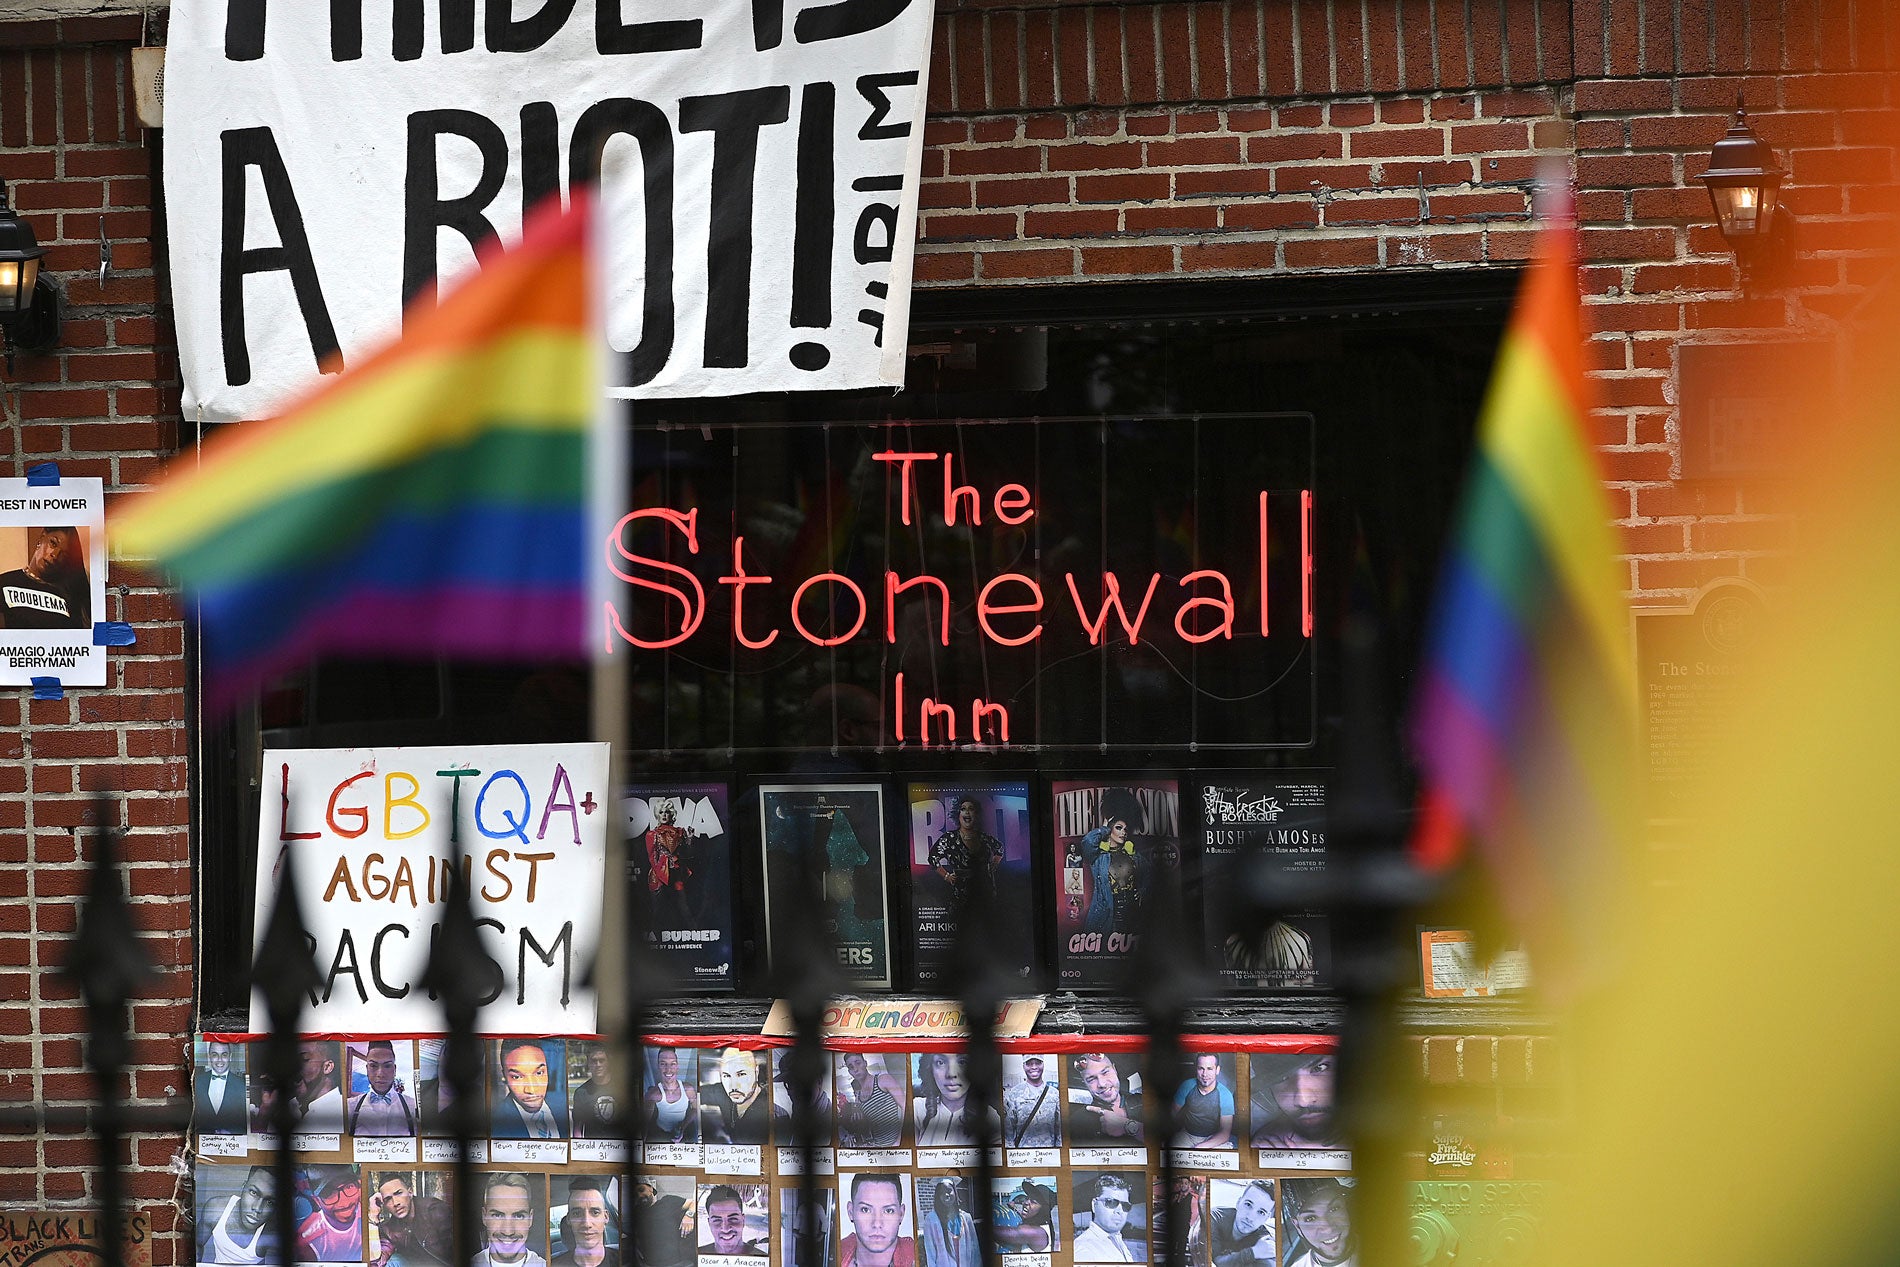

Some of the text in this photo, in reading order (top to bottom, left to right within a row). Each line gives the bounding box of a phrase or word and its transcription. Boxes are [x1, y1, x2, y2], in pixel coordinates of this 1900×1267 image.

[220, 126, 344, 386] A
[873, 450, 1034, 527] The
[29, 499, 41, 510] IN
[43, 498, 87, 510] POWER
[604, 489, 1312, 653] Stonewall
[48, 646, 90, 657] JAMAR
[9, 657, 76, 668] BERRYMAN
[1659, 662, 1688, 676] The
[896, 672, 1010, 742] Inn
[280, 762, 598, 846] LGBTQA+
[1054, 787, 1095, 838] THE
[1221, 812, 1278, 822] BOYLESQUE
[323, 849, 556, 908] AGAINST
[919, 922, 936, 932] ARI
[661, 930, 721, 942] BURNER
[820, 1002, 1012, 1028] orlandound
[261, 1134, 278, 1142] Shan
[304, 1134, 338, 1142] Tomlinson
[357, 1139, 377, 1147] Peter
[225, 1142, 240, 1150] Vega
[425, 1141, 444, 1149] Leroy
[517, 1142, 541, 1153] Eugene
[544, 1143, 566, 1155] Crosby
[572, 1142, 595, 1150] Jerald
[598, 1142, 621, 1150] Arthur
[708, 1146, 759, 1155] Luis Daniel
[1437, 1143, 1457, 1154] Fire
[471, 1152, 483, 1160] 25
[598, 1152, 607, 1160] 31
[647, 1153, 668, 1161] Torres
[838, 1151, 865, 1160] Alejandro
[1091, 1149, 1112, 1157] Daniel
[1117, 1149, 1138, 1158] Conde
[1261, 1151, 1285, 1159] Geraldo
[1428, 1151, 1476, 1166] Sprinkler
[730, 1165, 740, 1173] 37
[1193, 1160, 1216, 1168] Rosado
[1220, 1160, 1231, 1168] 35
[1416, 1183, 1472, 1202] AUTO
[78, 1216, 147, 1244] LIS
[700, 1257, 722, 1266] Oscar
